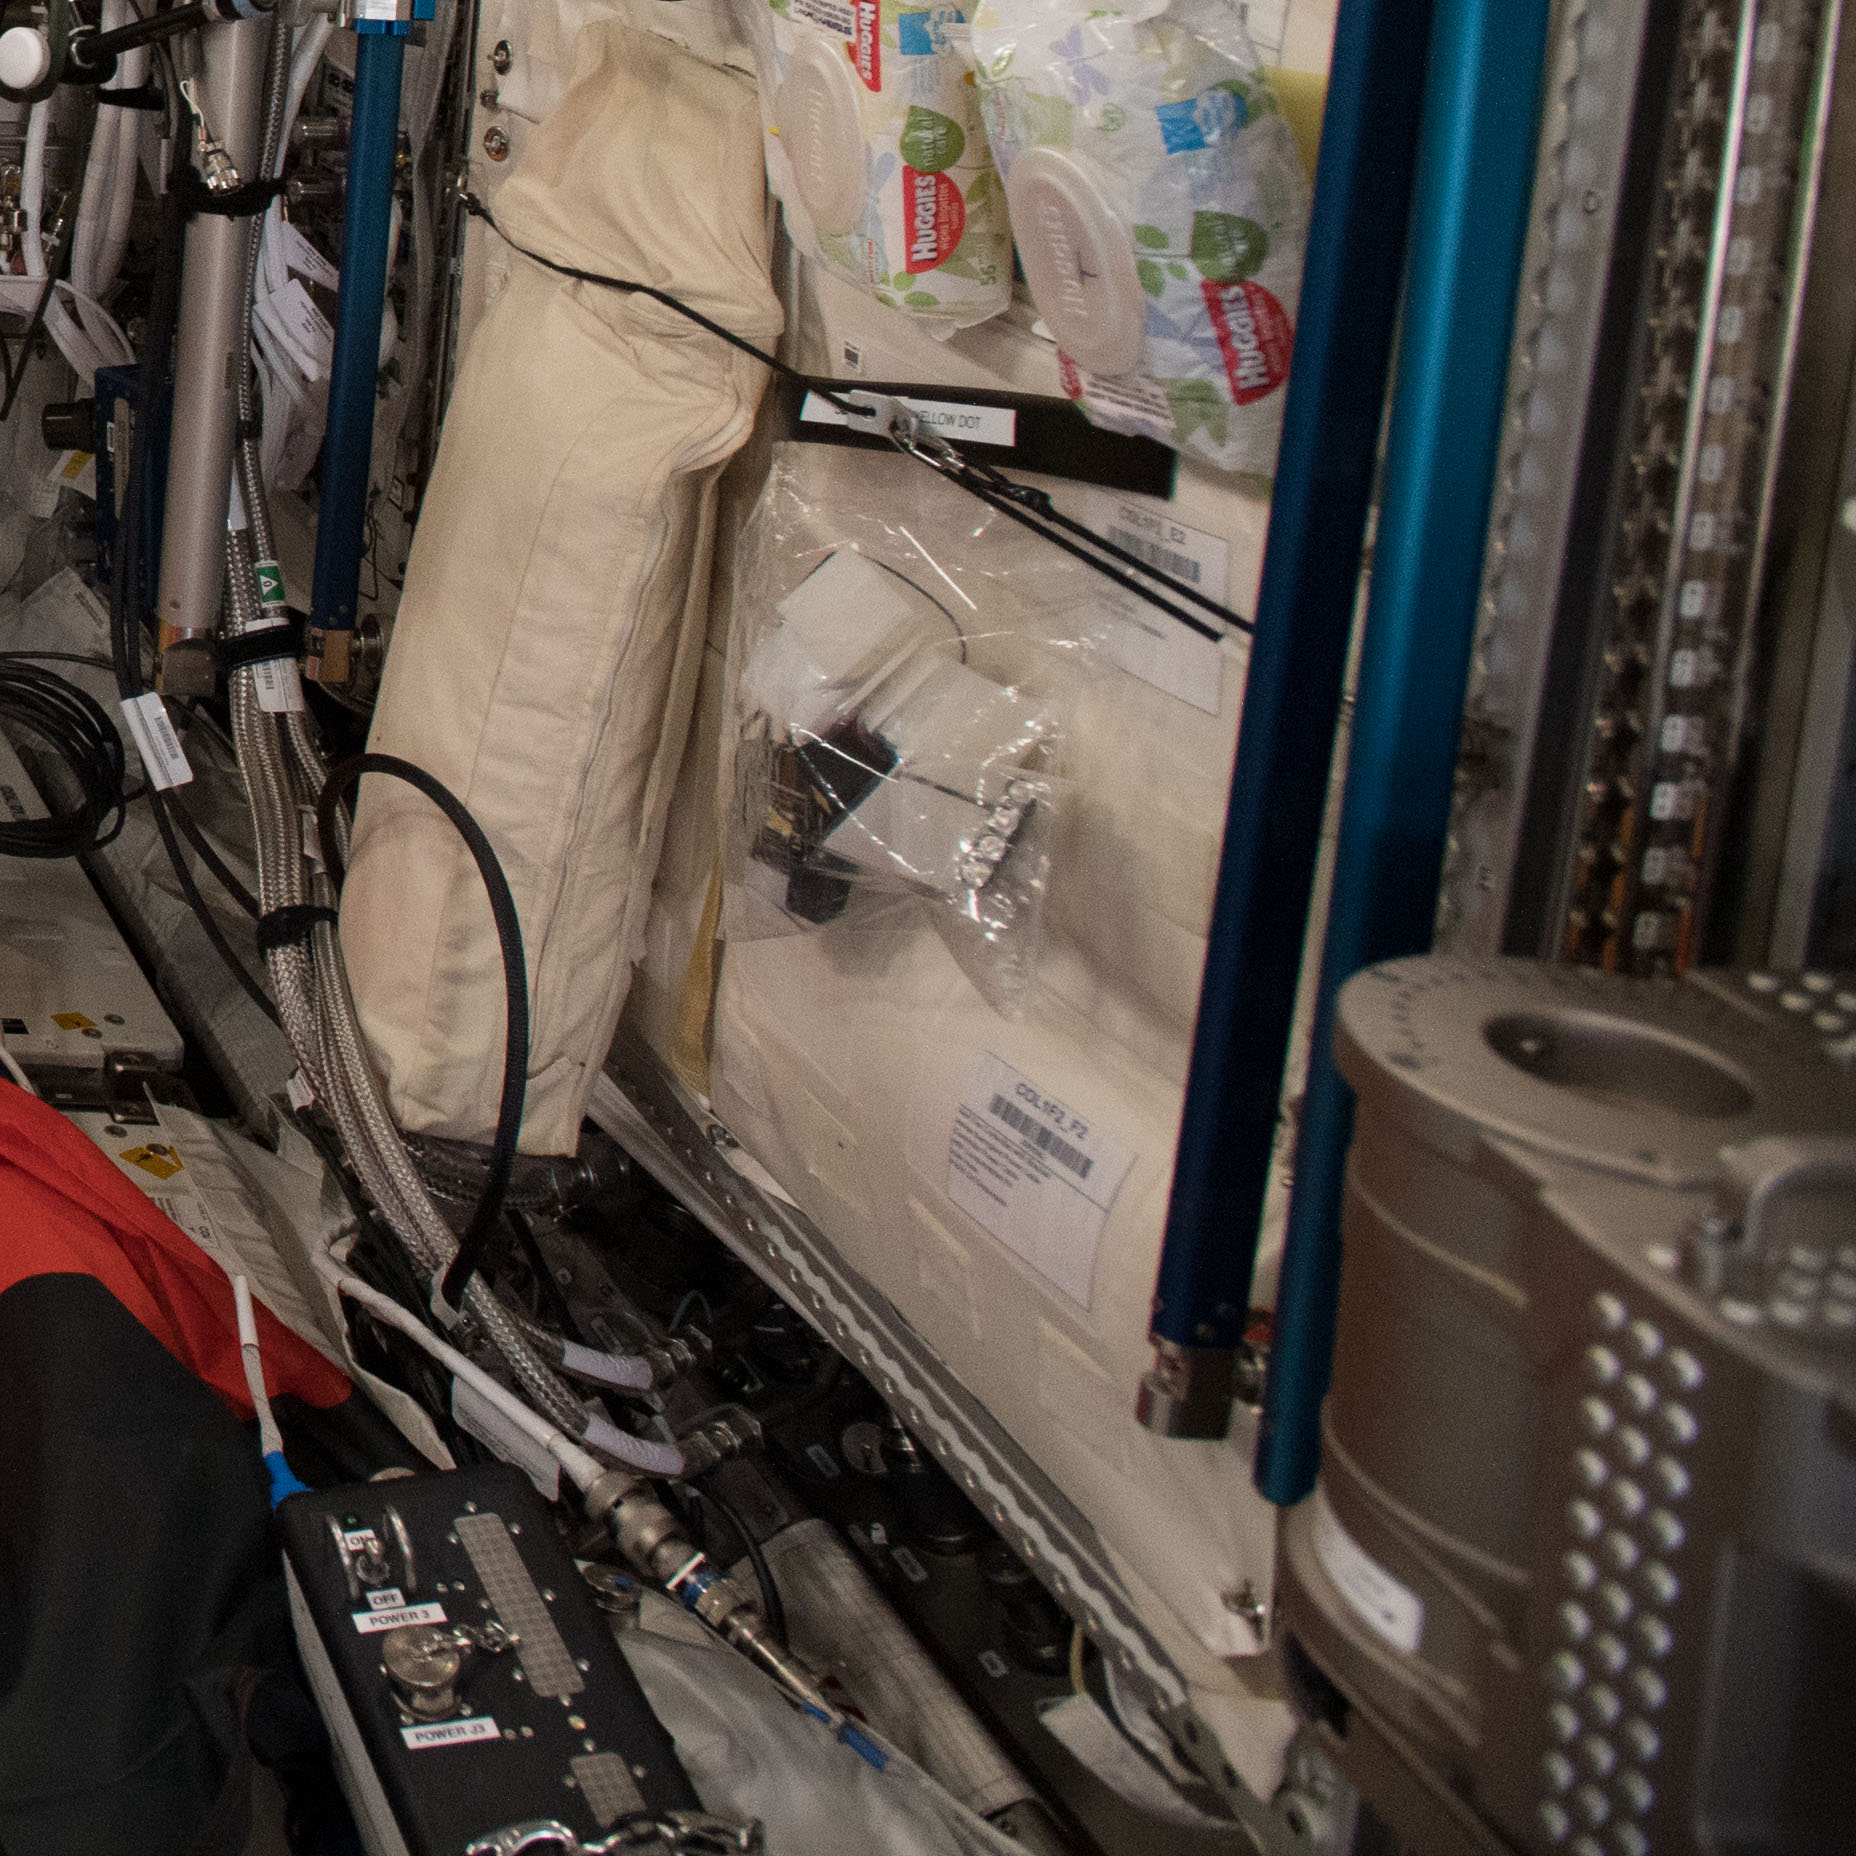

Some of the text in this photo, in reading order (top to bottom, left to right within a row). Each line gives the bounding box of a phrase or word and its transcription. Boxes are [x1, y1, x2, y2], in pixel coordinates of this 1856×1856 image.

[858, 0, 876, 81] HUGGIES
[912, 174, 938, 262] HUGGIES
[1219, 286, 1270, 390] HUGGIES
[921, 409, 982, 429] ELLOW DOT
[1015, 1083, 1088, 1142] COL1F2_F2
[370, 1610, 419, 1627] POWER
[373, 1593, 398, 1605] OFF
[415, 1724, 485, 1743] POWER J3
